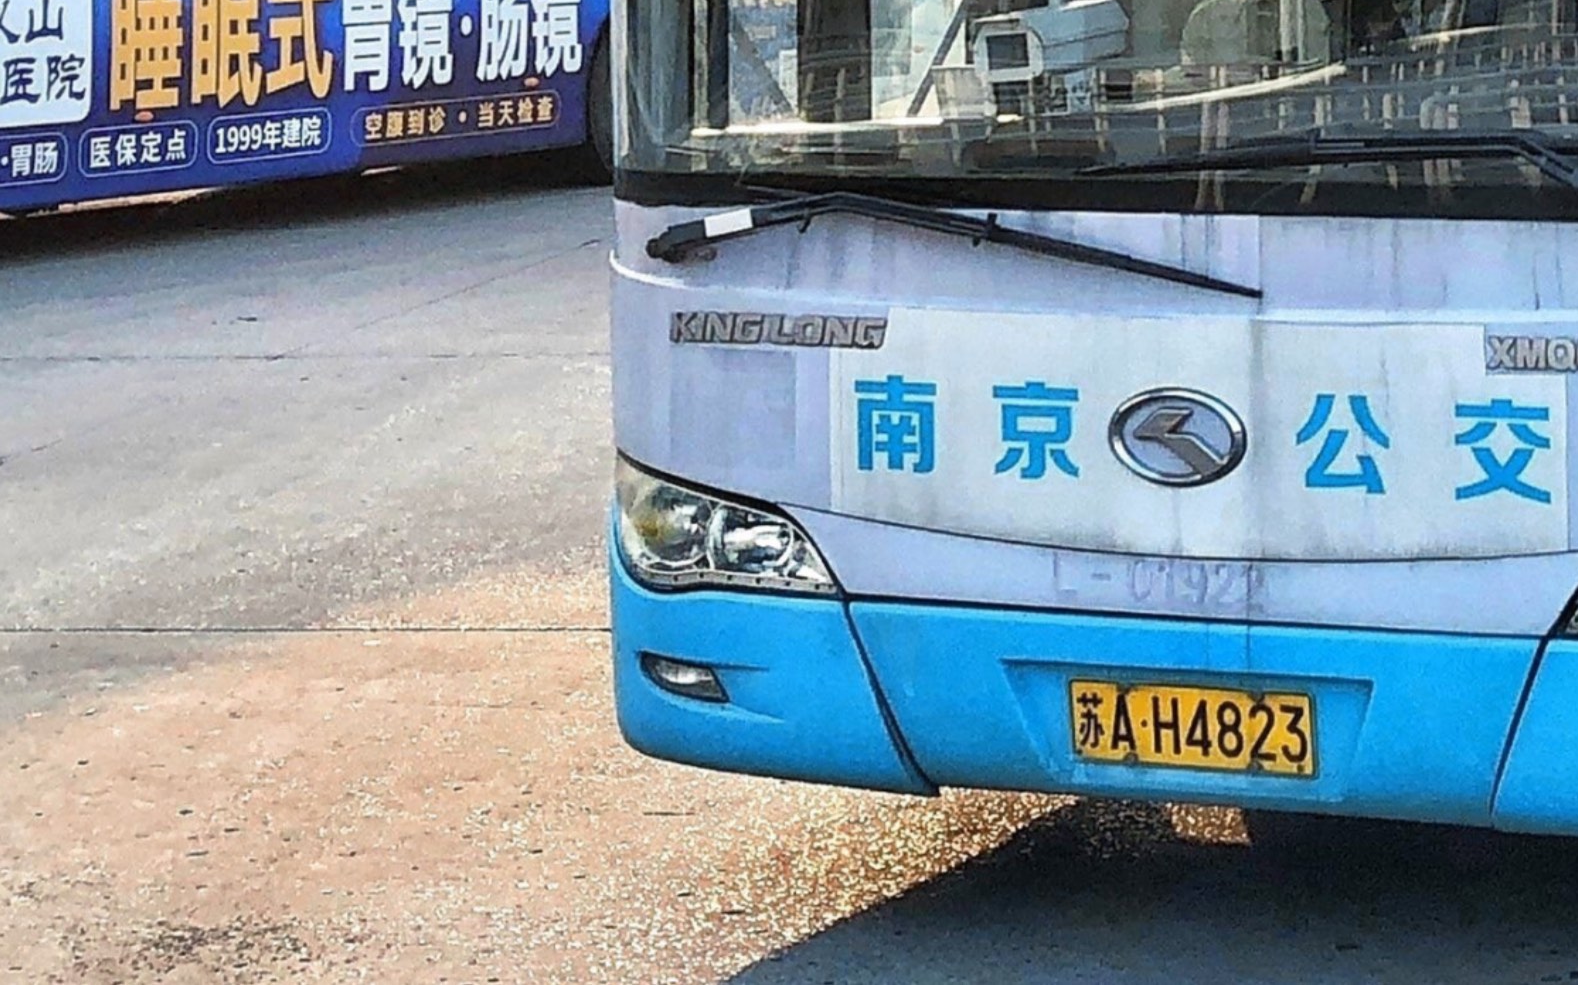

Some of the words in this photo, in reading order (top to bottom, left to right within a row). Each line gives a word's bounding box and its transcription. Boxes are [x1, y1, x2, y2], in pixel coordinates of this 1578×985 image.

[90, 128, 187, 169] 医保定点
[215, 115, 322, 154] 1999年建院
